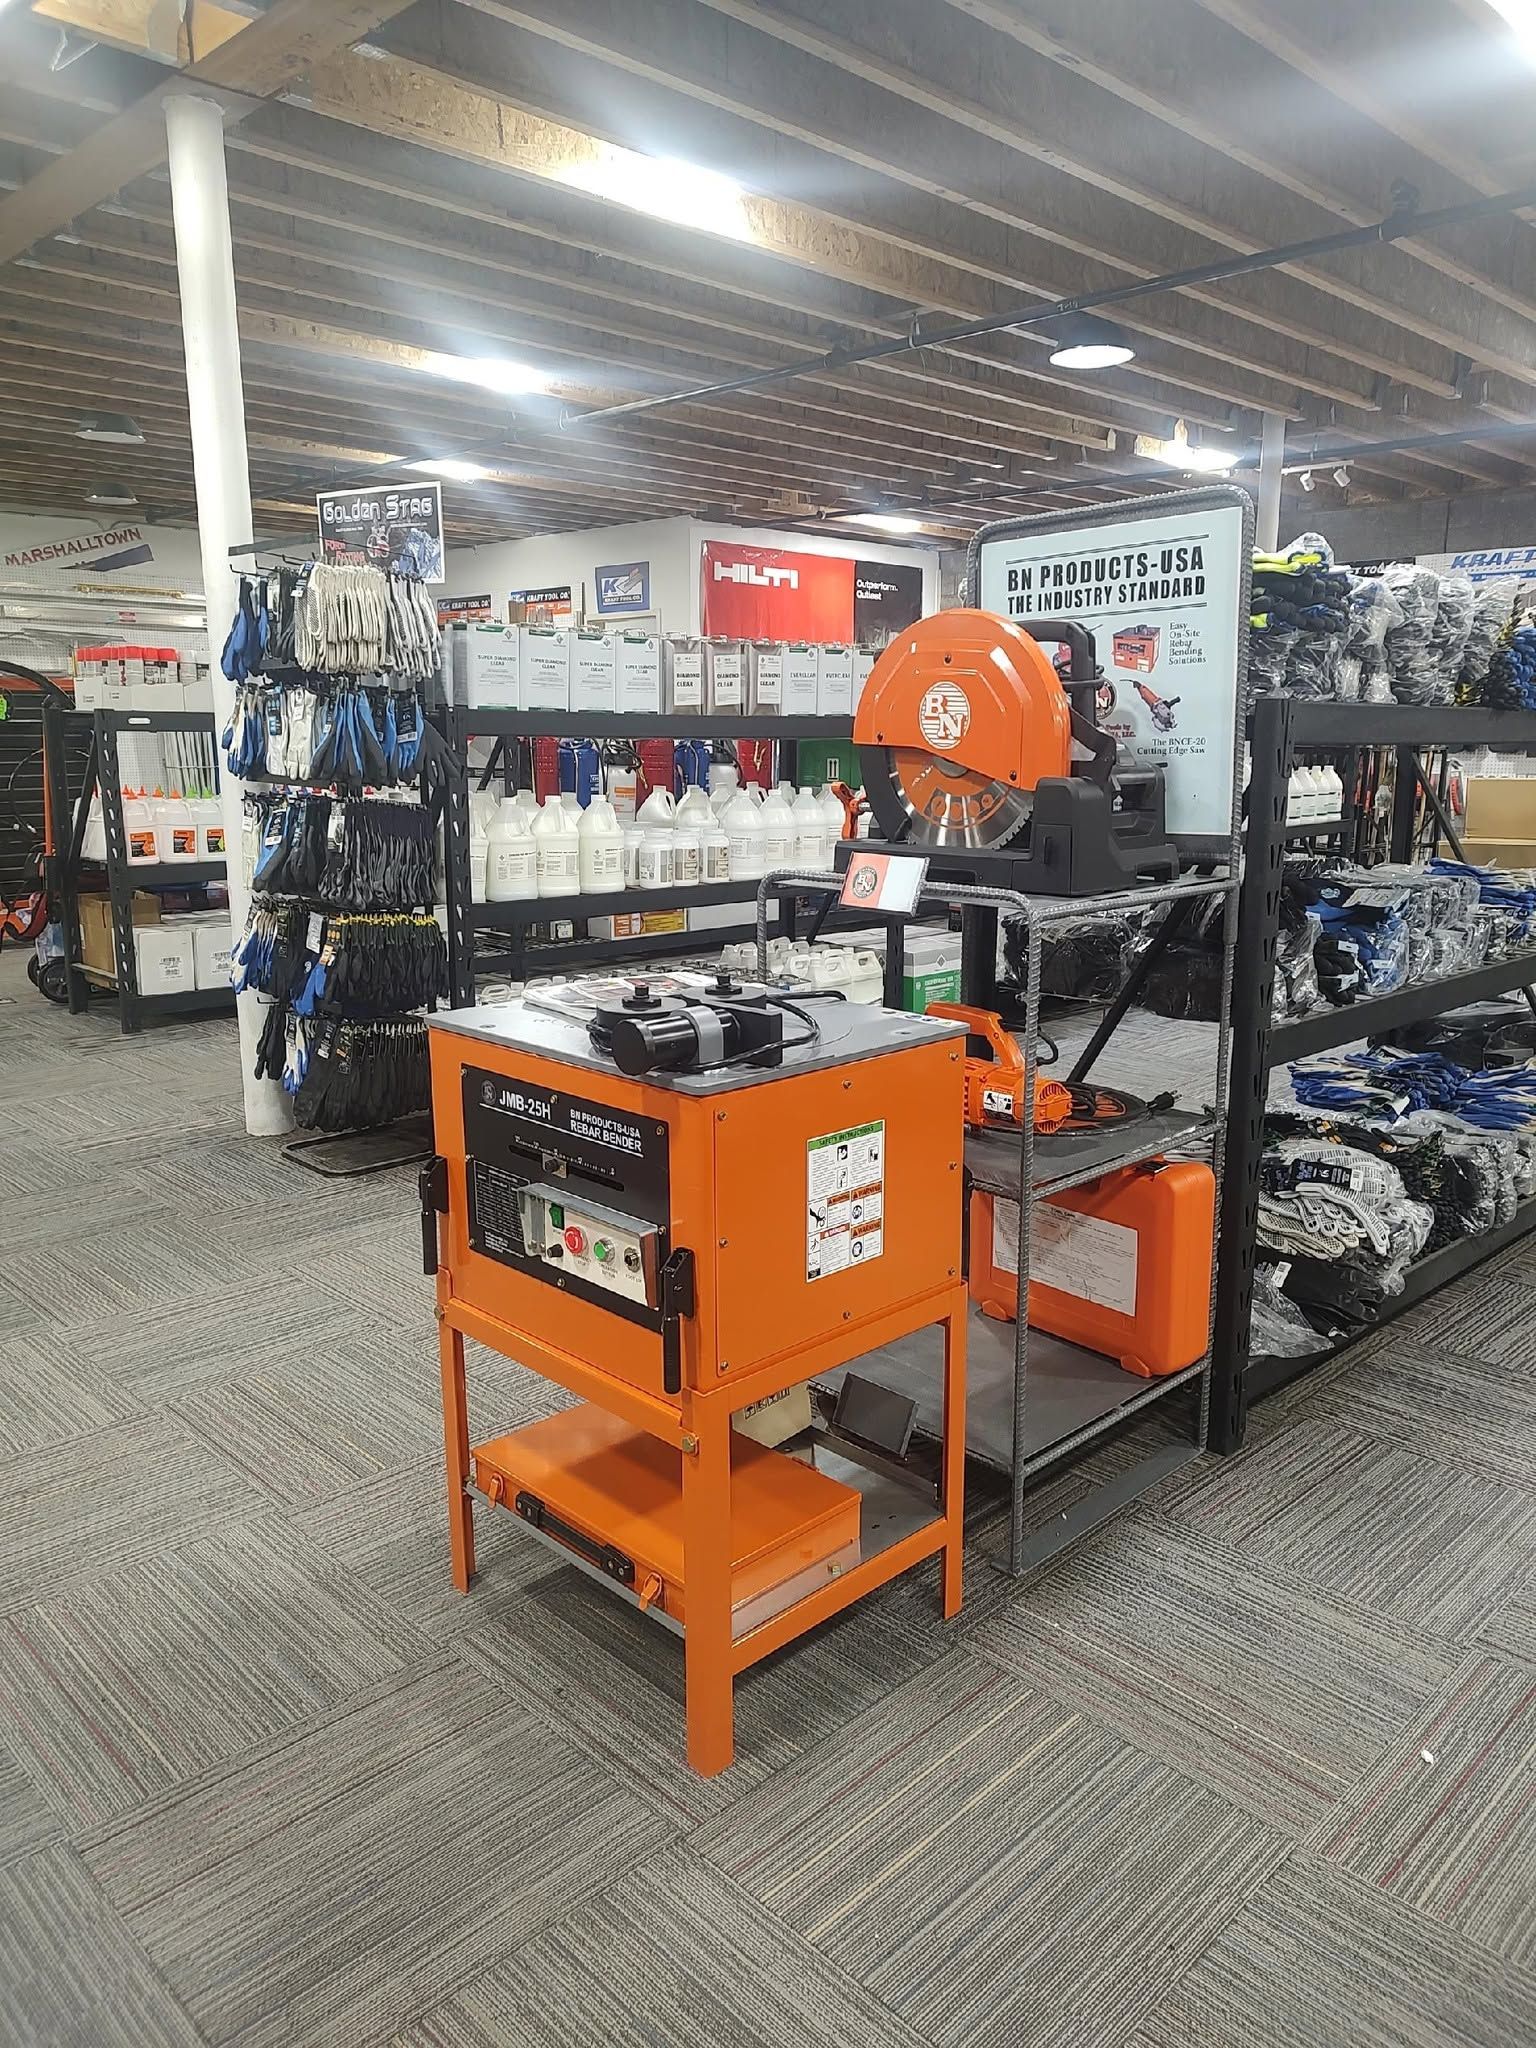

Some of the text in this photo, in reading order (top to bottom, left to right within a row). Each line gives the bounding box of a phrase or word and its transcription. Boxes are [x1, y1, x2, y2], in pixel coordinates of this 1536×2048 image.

[5, 527, 142, 566] MARSHALLTOWN
[1007, 545, 1204, 592] BN PRODUCTS-USA
[713, 561, 799, 590] HILTI
[526, 593, 544, 603] KRAFT
[544, 593, 559, 602] TOOL
[1008, 575, 1205, 614] THE INDUSTRY STANDARD
[451, 600, 467, 610] KRAFT
[1169, 622, 1188, 633] Easy
[1169, 630, 1201, 639] On-Site
[1169, 639, 1193, 649] Rebar
[1169, 646, 1203, 657] Bending
[1168, 656, 1207, 666] Solutions
[1152, 739, 1165, 747] The
[1137, 746, 1205, 757] Cutting Edge Saw
[499, 1090, 551, 1120] JMB-25H
[570, 1108, 641, 1139] BN PRODUCTS-USA
[570, 1119, 642, 1152] REBAR BENDER
[857, 1184, 881, 1197] WARNING
[857, 1221, 881, 1234] WARNING
